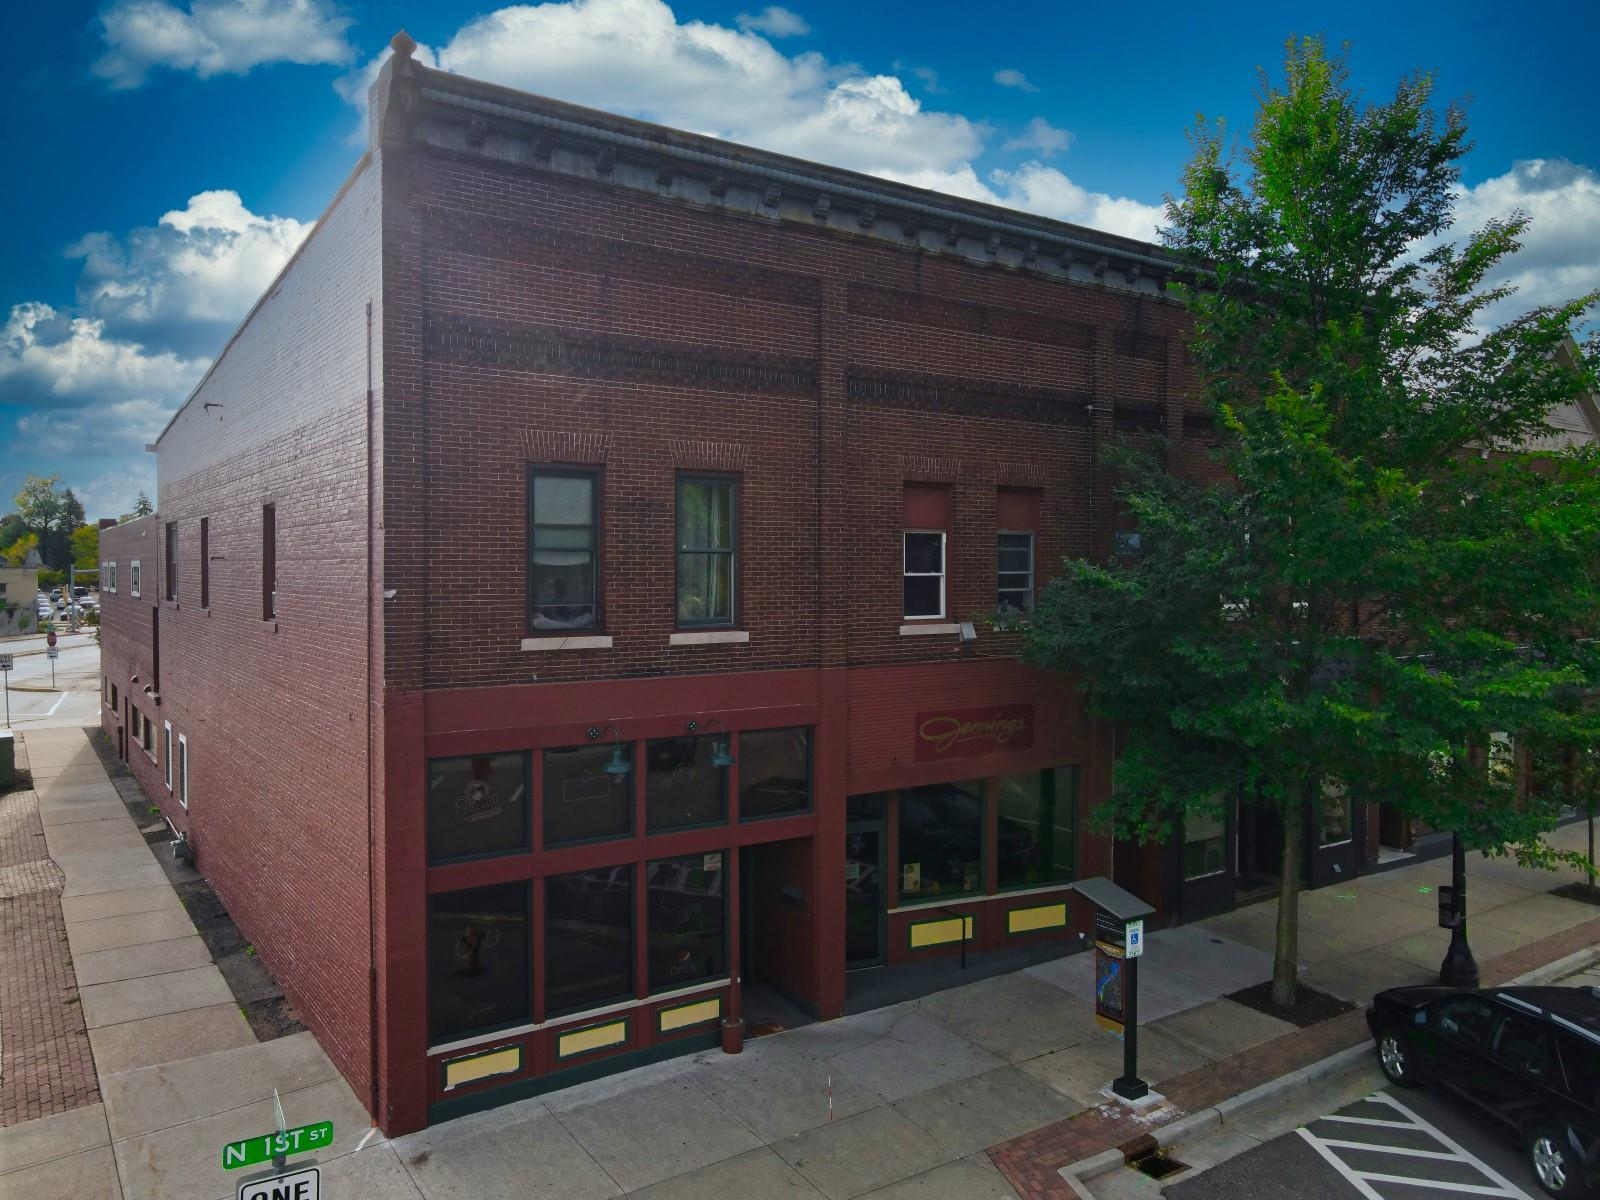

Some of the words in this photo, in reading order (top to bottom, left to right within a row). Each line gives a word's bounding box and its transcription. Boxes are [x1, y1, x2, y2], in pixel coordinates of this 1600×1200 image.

[919, 713, 1030, 753] Jennings
[226, 1142, 246, 1166] N
[265, 1130, 304, 1156] 1ST
[310, 1128, 328, 1141] ST
